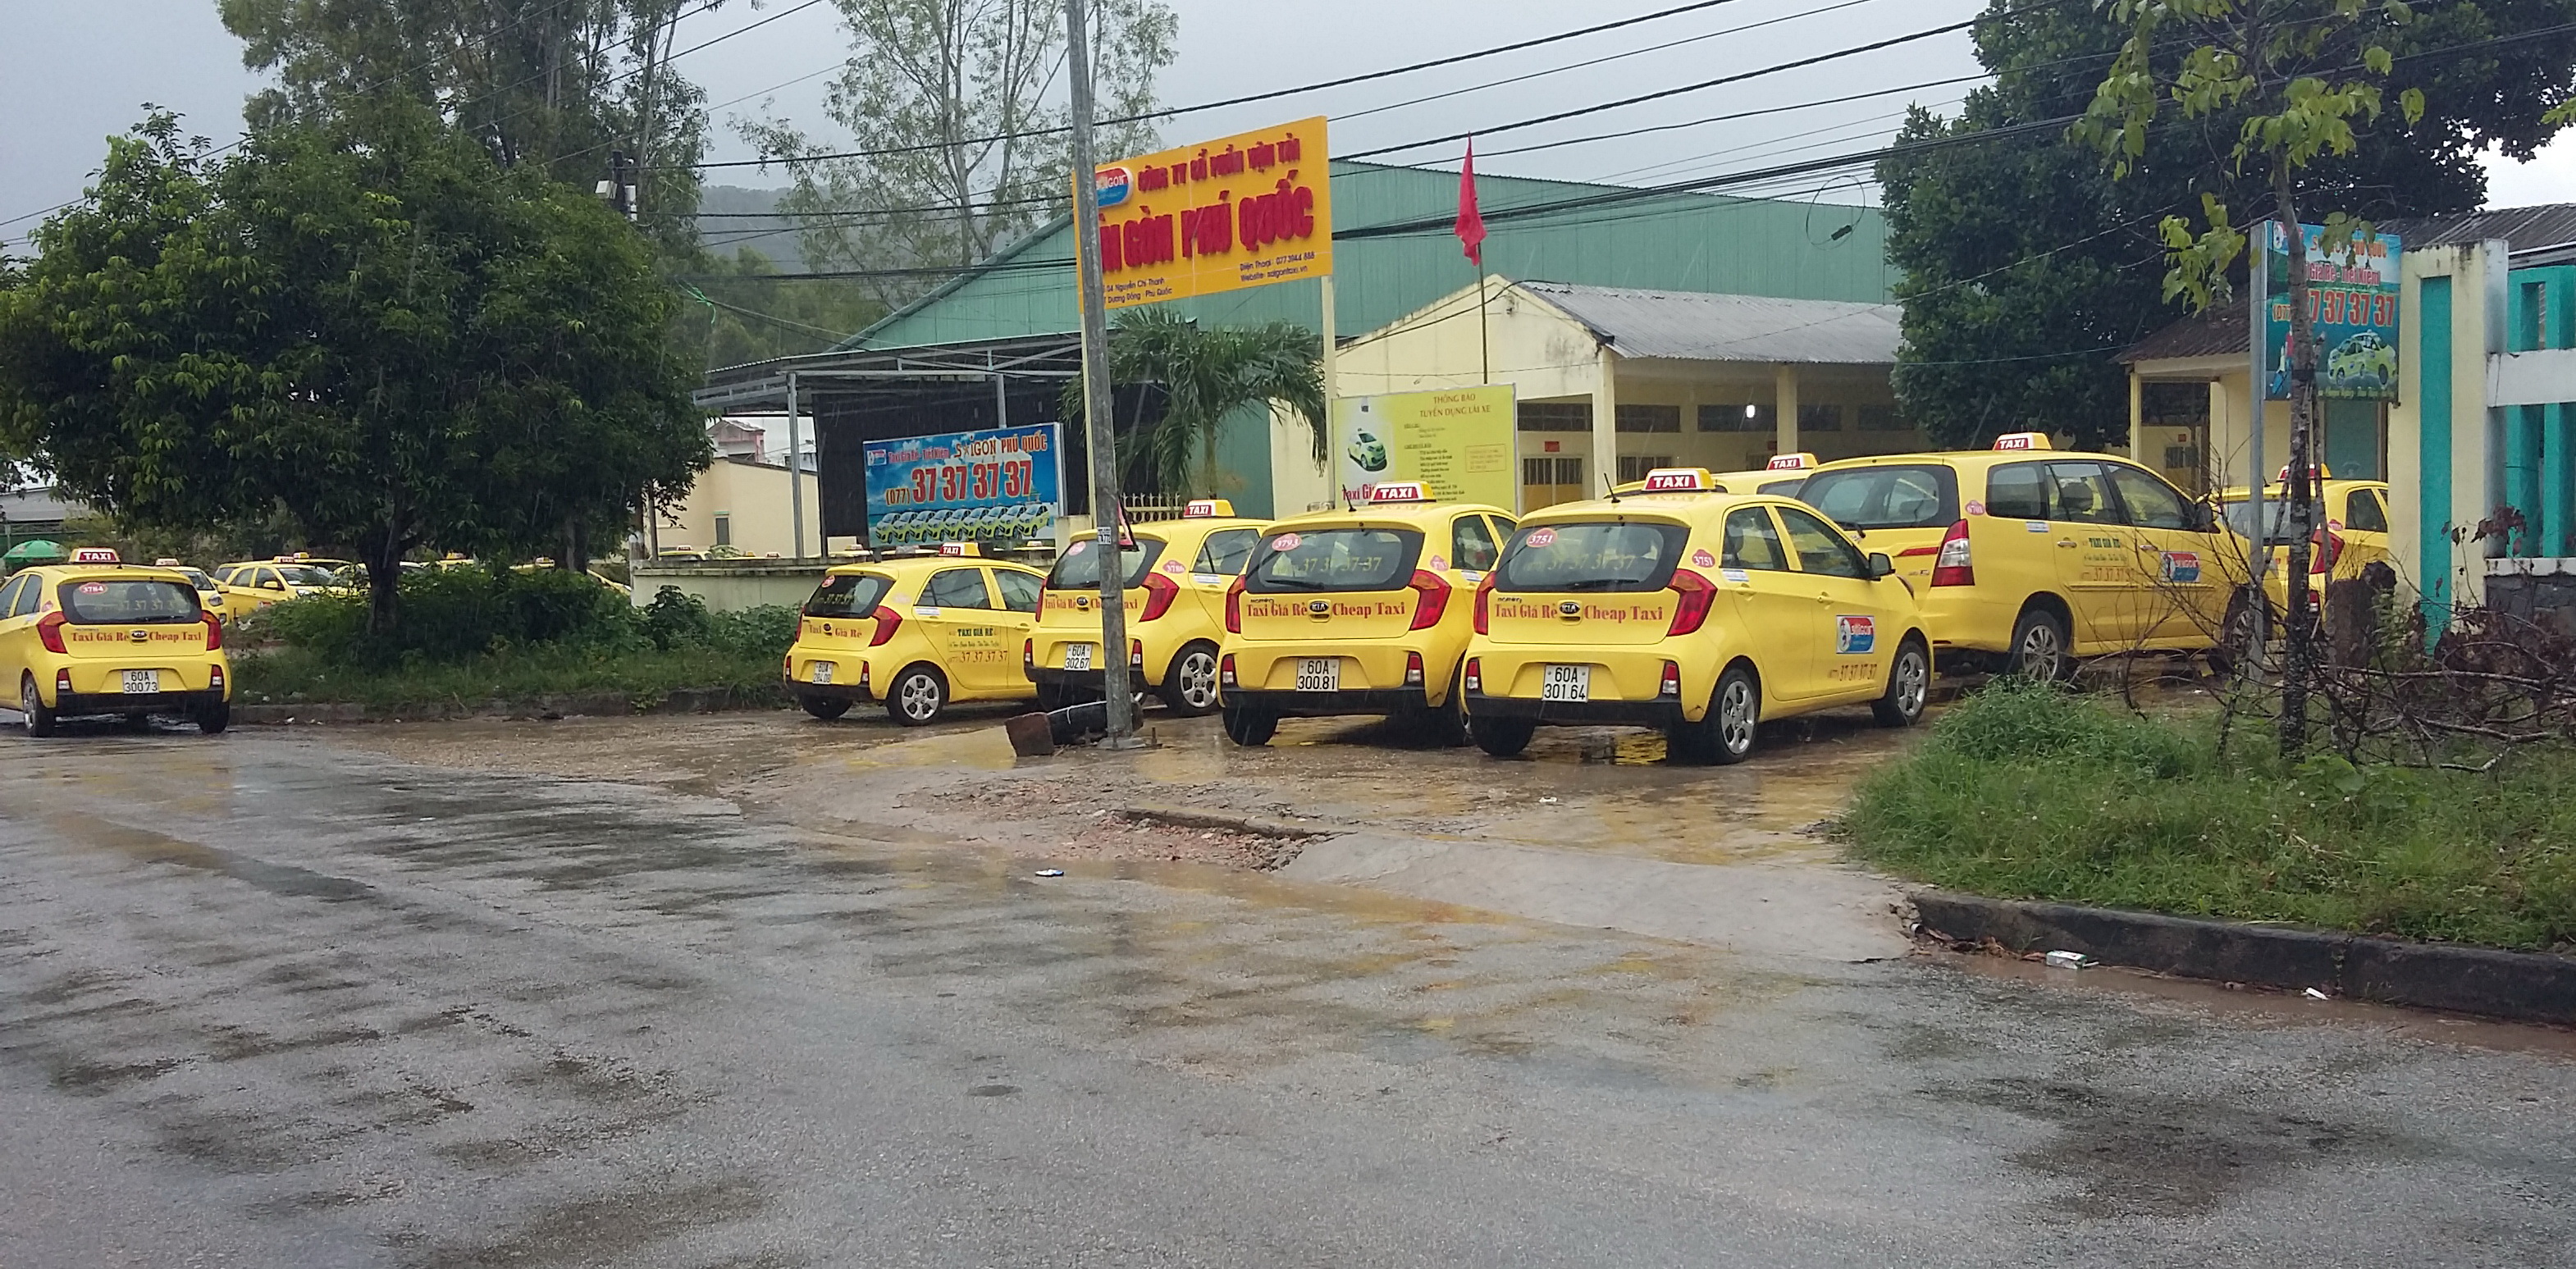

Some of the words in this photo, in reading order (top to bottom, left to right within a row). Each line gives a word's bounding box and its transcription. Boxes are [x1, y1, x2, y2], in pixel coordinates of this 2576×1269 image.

[1181, 189, 1232, 258] PHÚ
[1239, 169, 1313, 253] QUỐC
[2323, 290, 2346, 324] 37
[2348, 292, 2371, 326] 37
[2373, 294, 2396, 327] 37
[1999, 438, 2026, 450] TAXI
[1773, 459, 1797, 468] TAXI
[885, 488, 911, 506] (077)
[911, 468, 937, 504] 37
[942, 465, 968, 501] 37
[973, 463, 999, 500] 37
[1005, 460, 1032, 497] 37
[1653, 476, 1690, 489] TAXI
[1380, 488, 1413, 499] TAXI
[1189, 506, 1209, 515] TAXI
[1529, 534, 1553, 544] 3751
[84, 552, 112, 561] TAXI
[943, 546, 960, 555] TAXI
[1693, 555, 1714, 567] 3751
[1246, 604, 1268, 617] Taxi
[1271, 601, 1289, 617] Giá
[1311, 603, 1328, 612] KIA
[1332, 603, 1372, 619] Cheap
[1376, 601, 1406, 616] Taxi
[1495, 603, 1517, 619] Taxi
[1519, 603, 1538, 619] Giá
[1561, 603, 1579, 612] KIA
[1584, 605, 1627, 623] Cheap
[1630, 606, 1663, 621] Taxi
[72, 632, 93, 641] Taxi
[96, 632, 113, 641] Giá
[149, 632, 179, 643] Cheap
[182, 631, 202, 641] Taxi
[957, 628, 972, 637] TAXI
[1071, 645, 1086, 657] 60A
[1307, 661, 1329, 676] 60A
[1555, 667, 1578, 682] 60A
[131, 672, 150, 682] 60A
